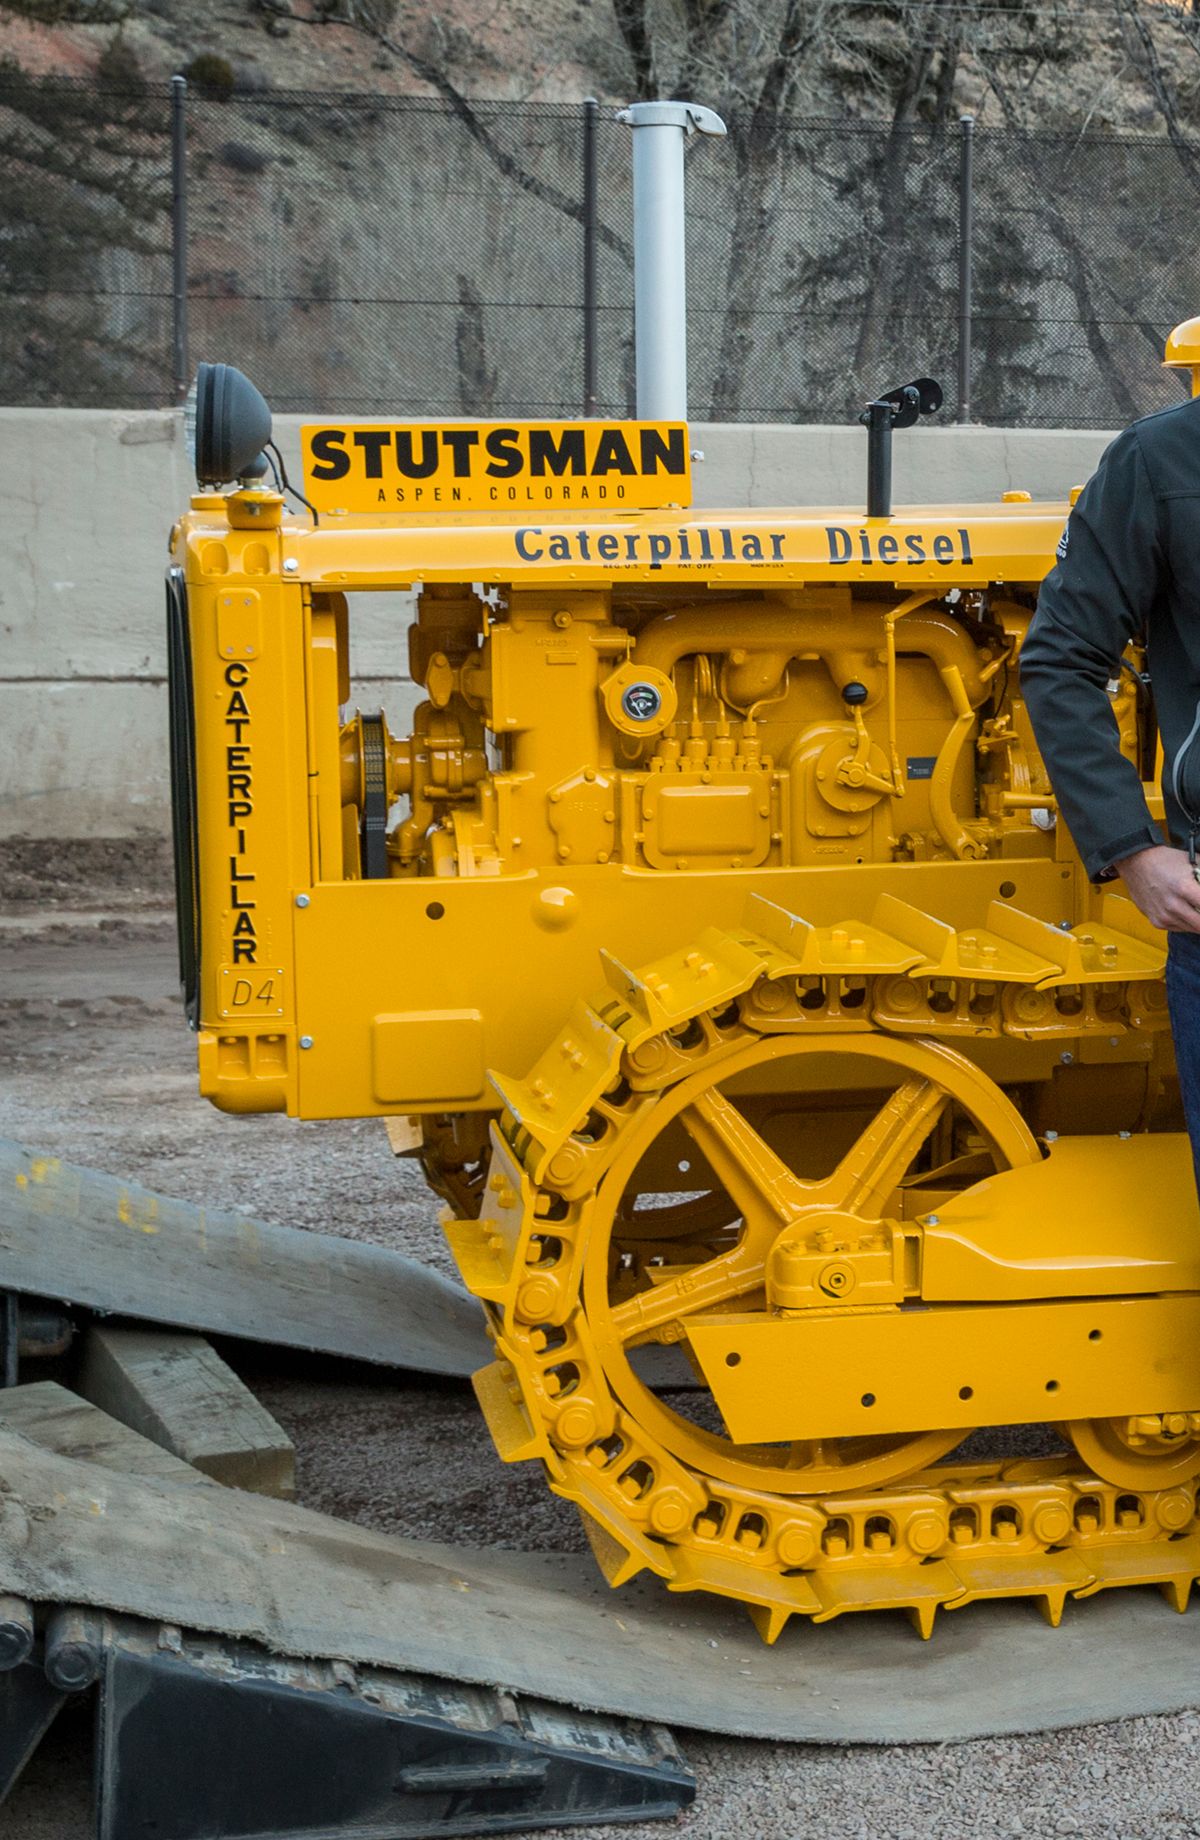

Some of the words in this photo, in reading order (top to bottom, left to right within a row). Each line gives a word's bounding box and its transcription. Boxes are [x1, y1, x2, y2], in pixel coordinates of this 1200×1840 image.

[310, 428, 686, 480] STUTSMAN
[490, 485, 625, 501] COLORADO
[515, 528, 786, 570] Caterpillar
[825, 527, 974, 565] Diesel
[224, 662, 258, 964] CATERPILLAR
[232, 979, 275, 1007] D4
